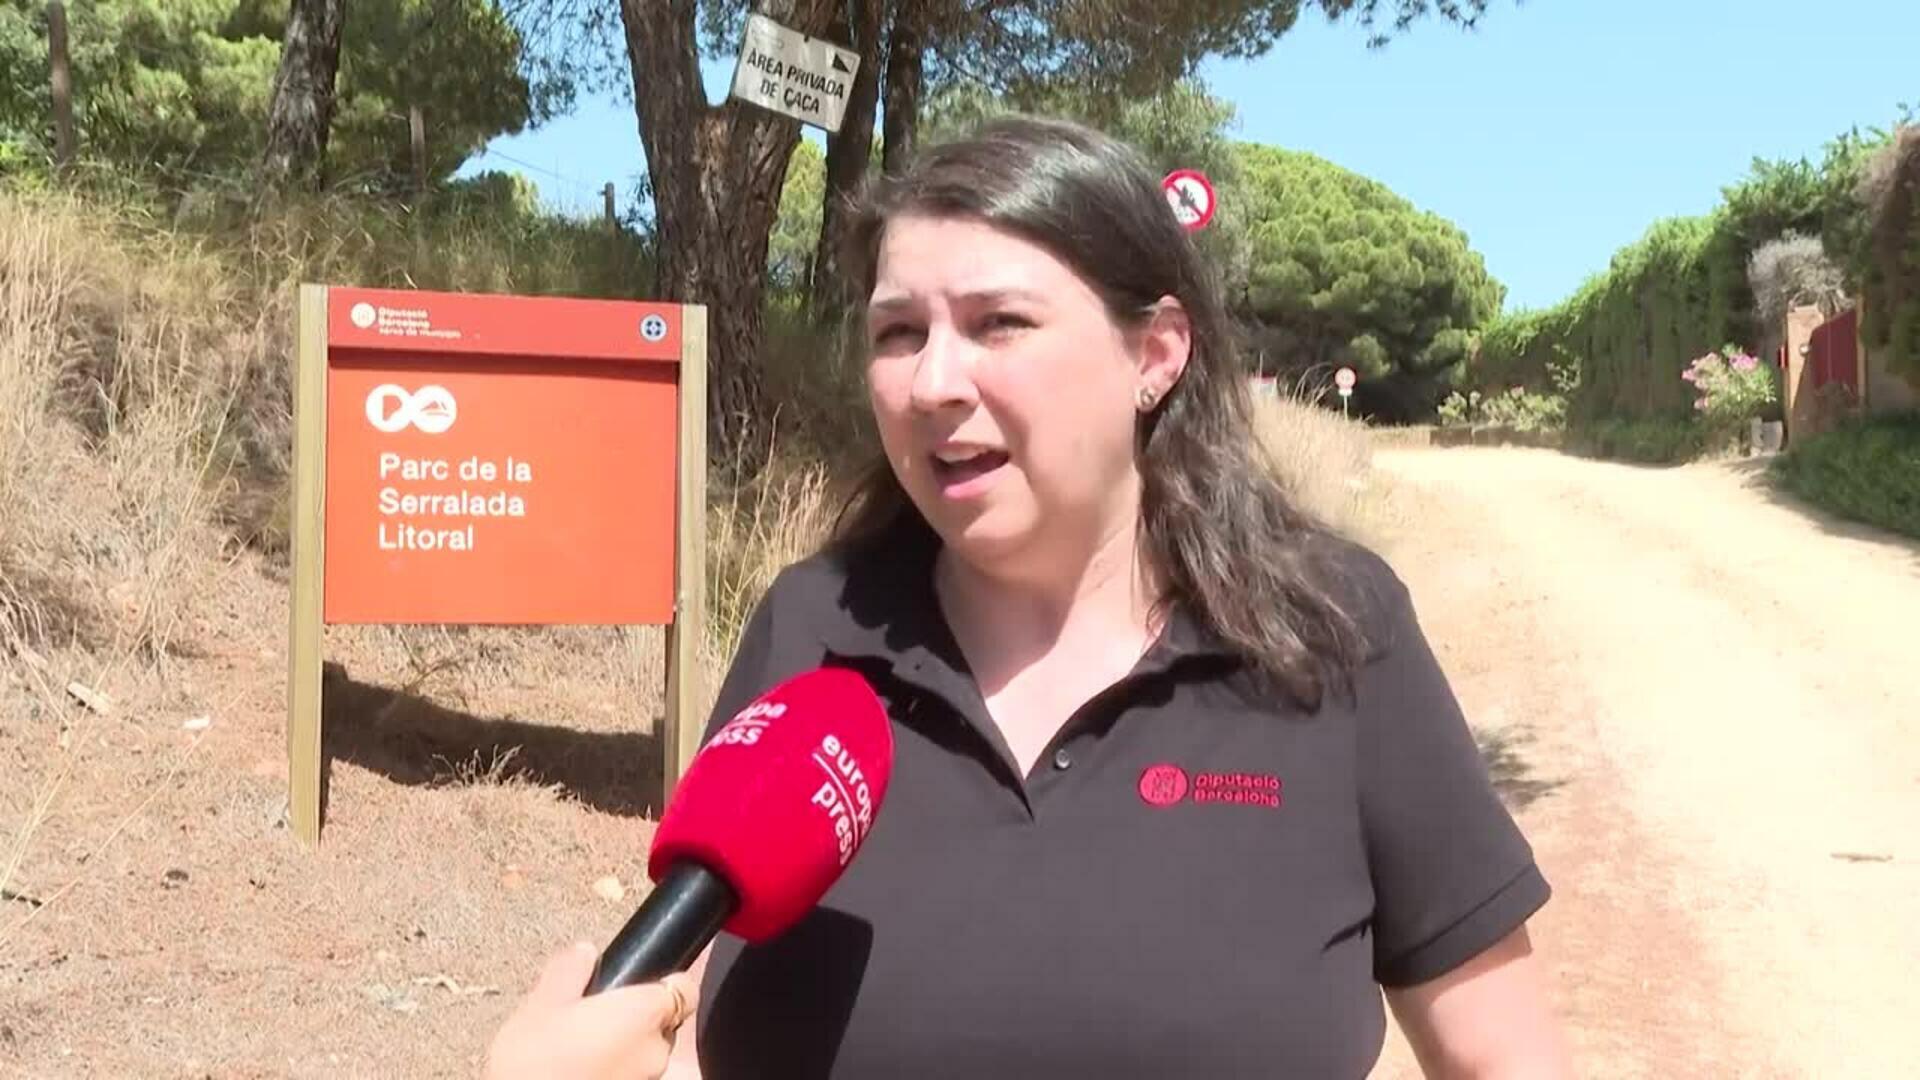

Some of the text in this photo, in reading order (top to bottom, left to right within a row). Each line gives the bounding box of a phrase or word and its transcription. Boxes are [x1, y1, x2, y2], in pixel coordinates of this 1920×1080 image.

[760, 78, 779, 97] DE
[787, 65, 844, 99] PRIVADA
[379, 452, 532, 482] Parc de la
[378, 487, 525, 516] Serralada
[378, 523, 474, 551] Litoral
